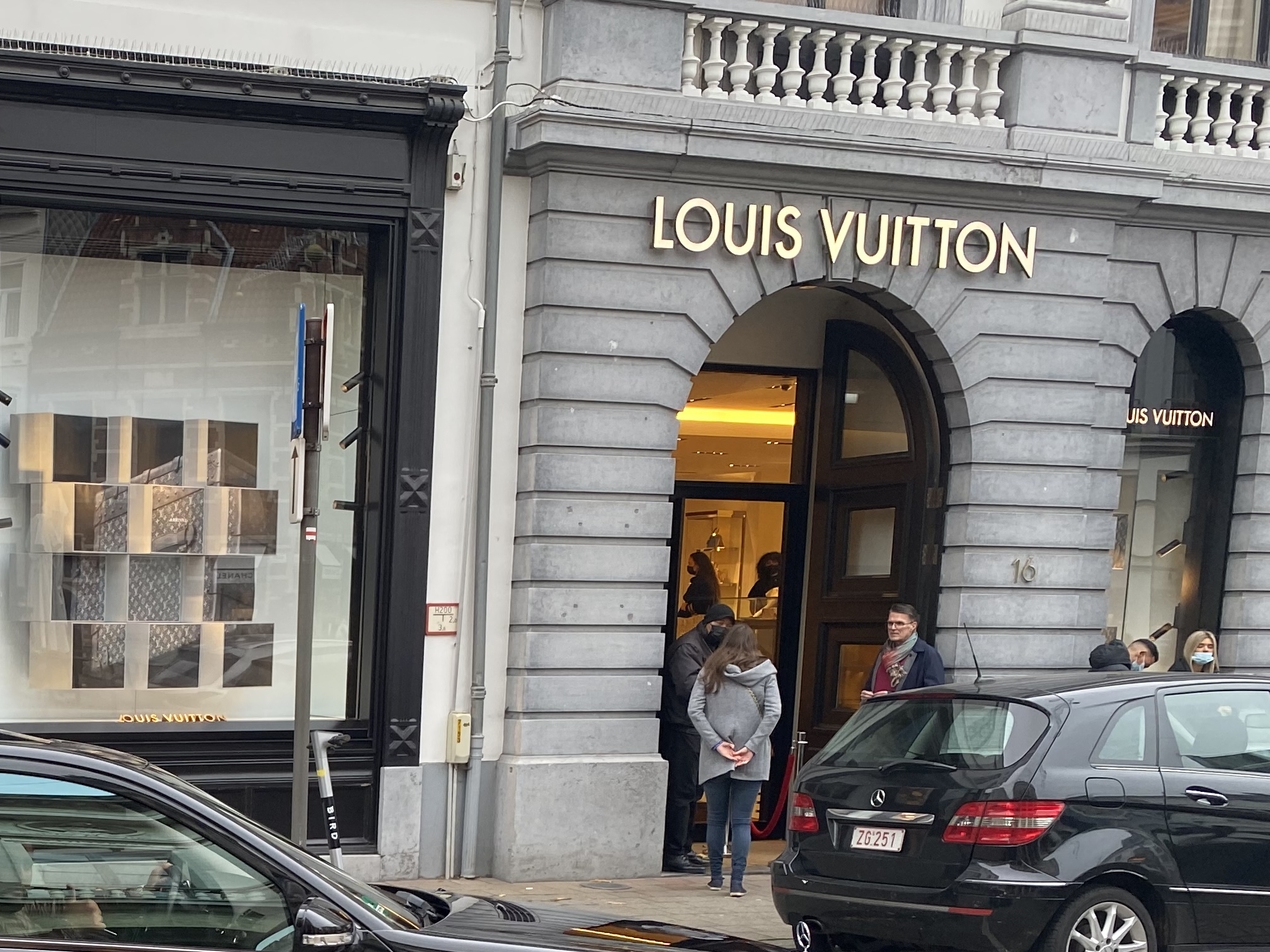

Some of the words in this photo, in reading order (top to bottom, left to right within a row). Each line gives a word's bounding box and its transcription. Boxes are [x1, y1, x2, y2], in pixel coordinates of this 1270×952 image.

[653, 195, 803, 259] LOUIS
[820, 208, 1037, 278] VUITTON
[1152, 408, 1214, 427] VUITTON
[1011, 555, 1036, 584] 16
[118, 713, 158, 723] LOUIS
[162, 713, 227, 723] VUITTON
[326, 805, 339, 840] BIRD
